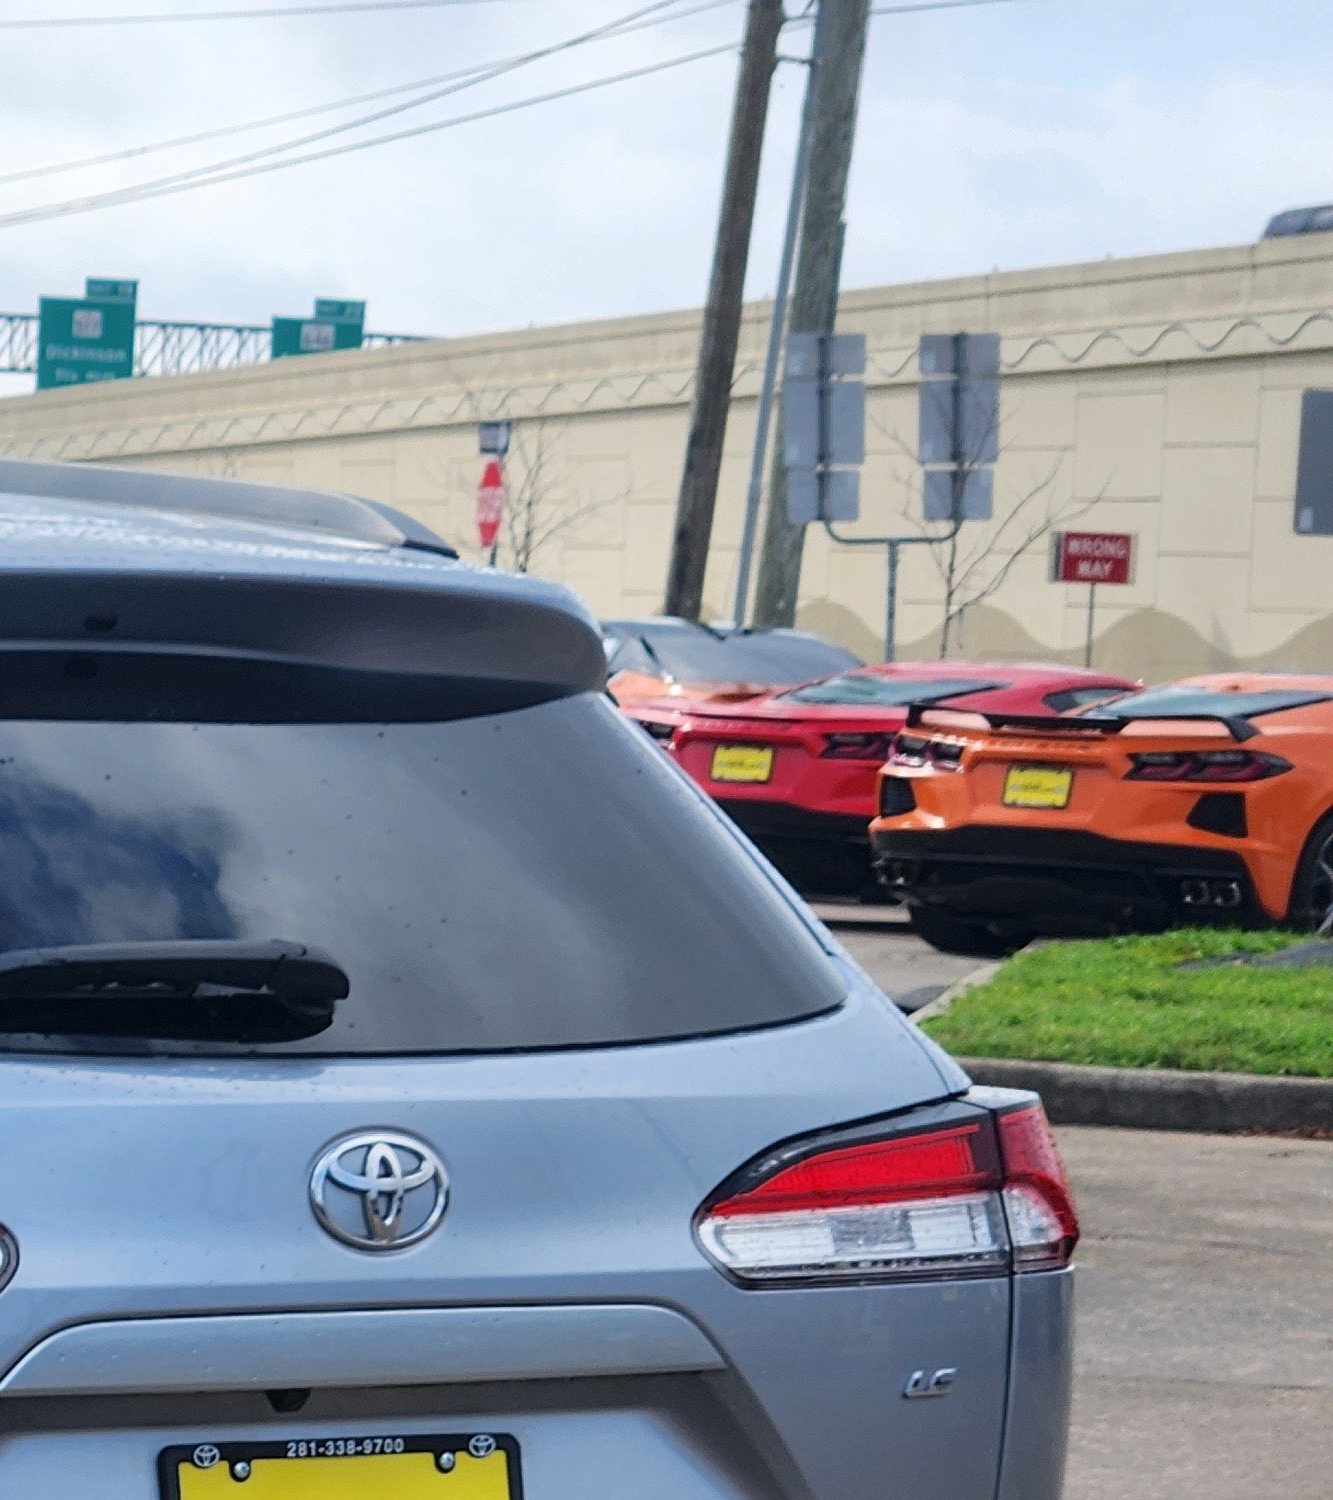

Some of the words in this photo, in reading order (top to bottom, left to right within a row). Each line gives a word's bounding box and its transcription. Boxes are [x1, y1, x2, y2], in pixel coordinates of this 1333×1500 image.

[1068, 537, 1127, 558] WRONG
[1077, 559, 1113, 578] WAY
[286, 1438, 405, 1458] 281-338-9700
